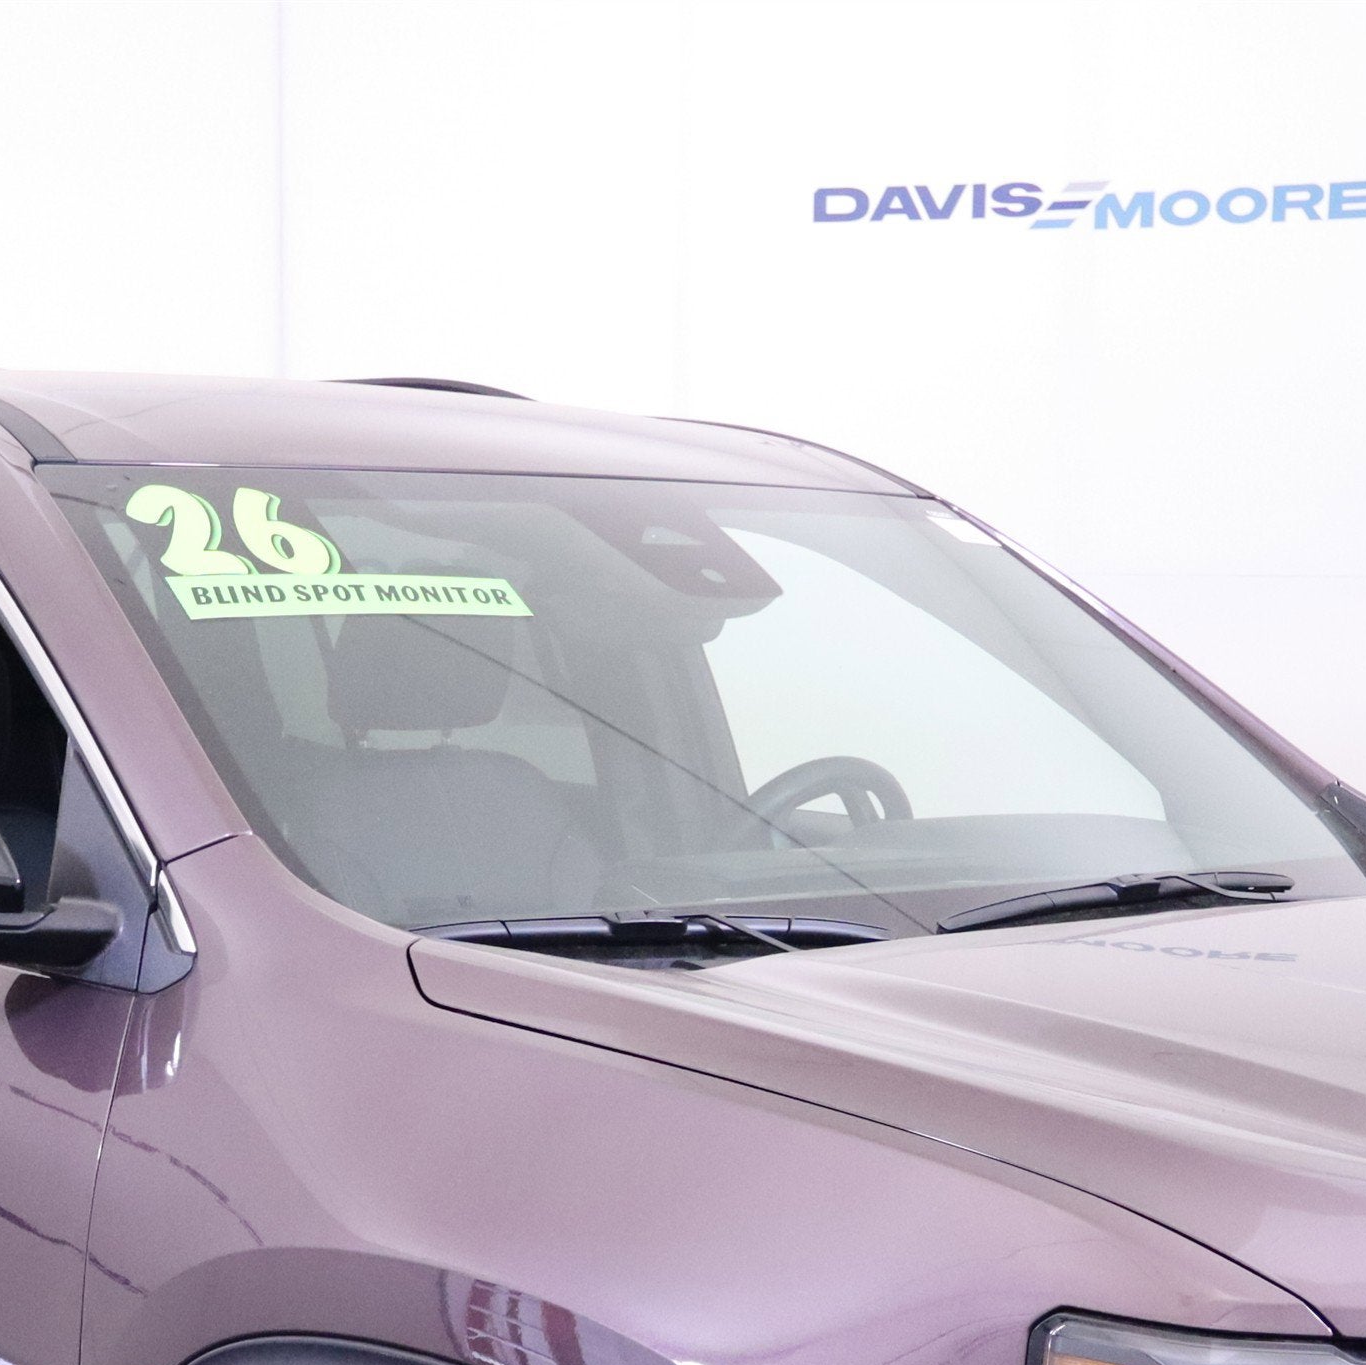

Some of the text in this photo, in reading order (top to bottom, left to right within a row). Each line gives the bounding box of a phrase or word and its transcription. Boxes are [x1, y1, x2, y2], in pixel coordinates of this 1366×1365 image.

[813, 181, 1043, 223] DAVIS
[126, 484, 341, 576] 26
[191, 584, 513, 606] BLIND SPOT MONITOR
